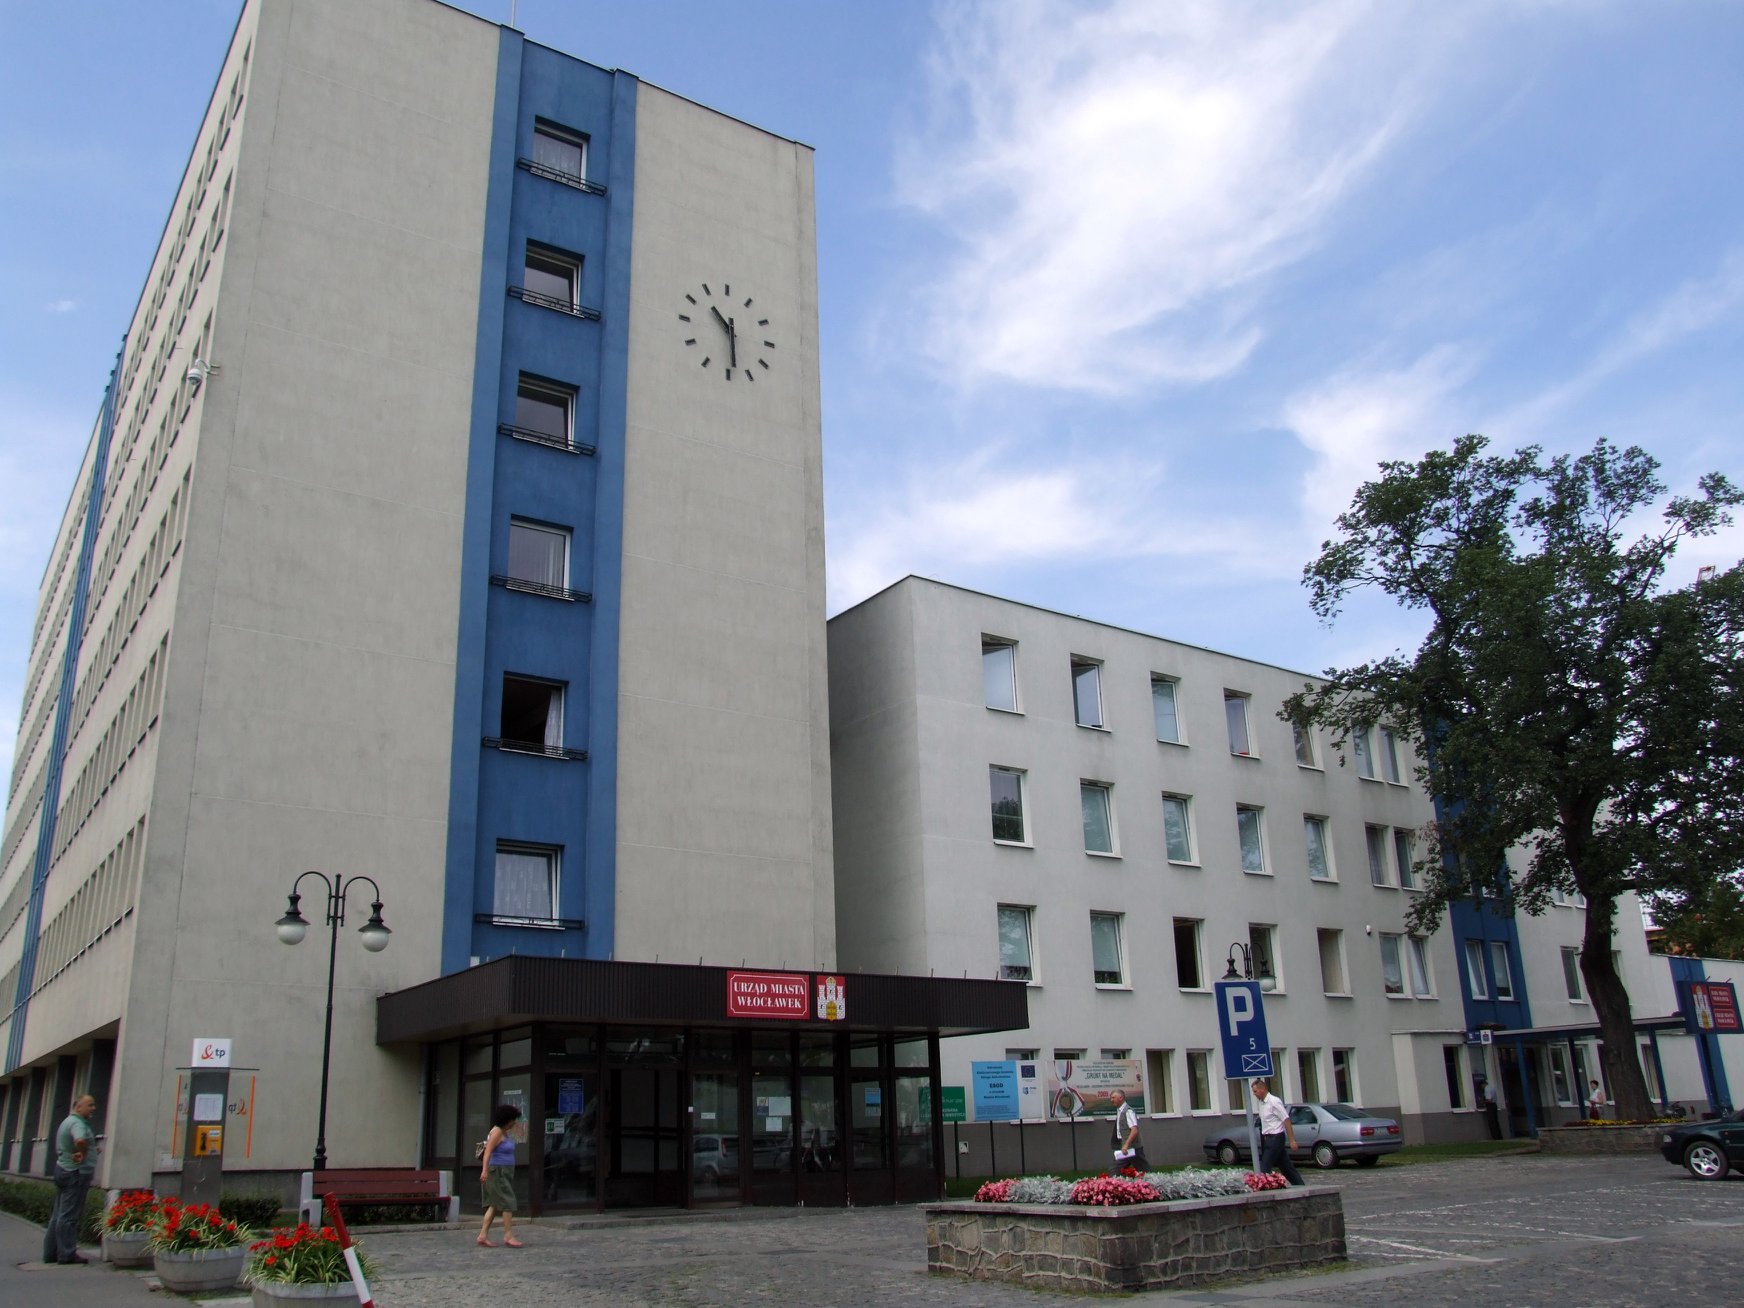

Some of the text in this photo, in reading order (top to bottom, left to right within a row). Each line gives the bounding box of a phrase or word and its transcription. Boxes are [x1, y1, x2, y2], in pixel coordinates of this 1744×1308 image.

[734, 982, 804, 995] URZĄD MIASTA
[737, 996, 801, 1008] WŁOCŁAWEK
[1225, 987, 1254, 1036] P
[1249, 1038, 1256, 1050] 5
[215, 1048, 225, 1058] tp
